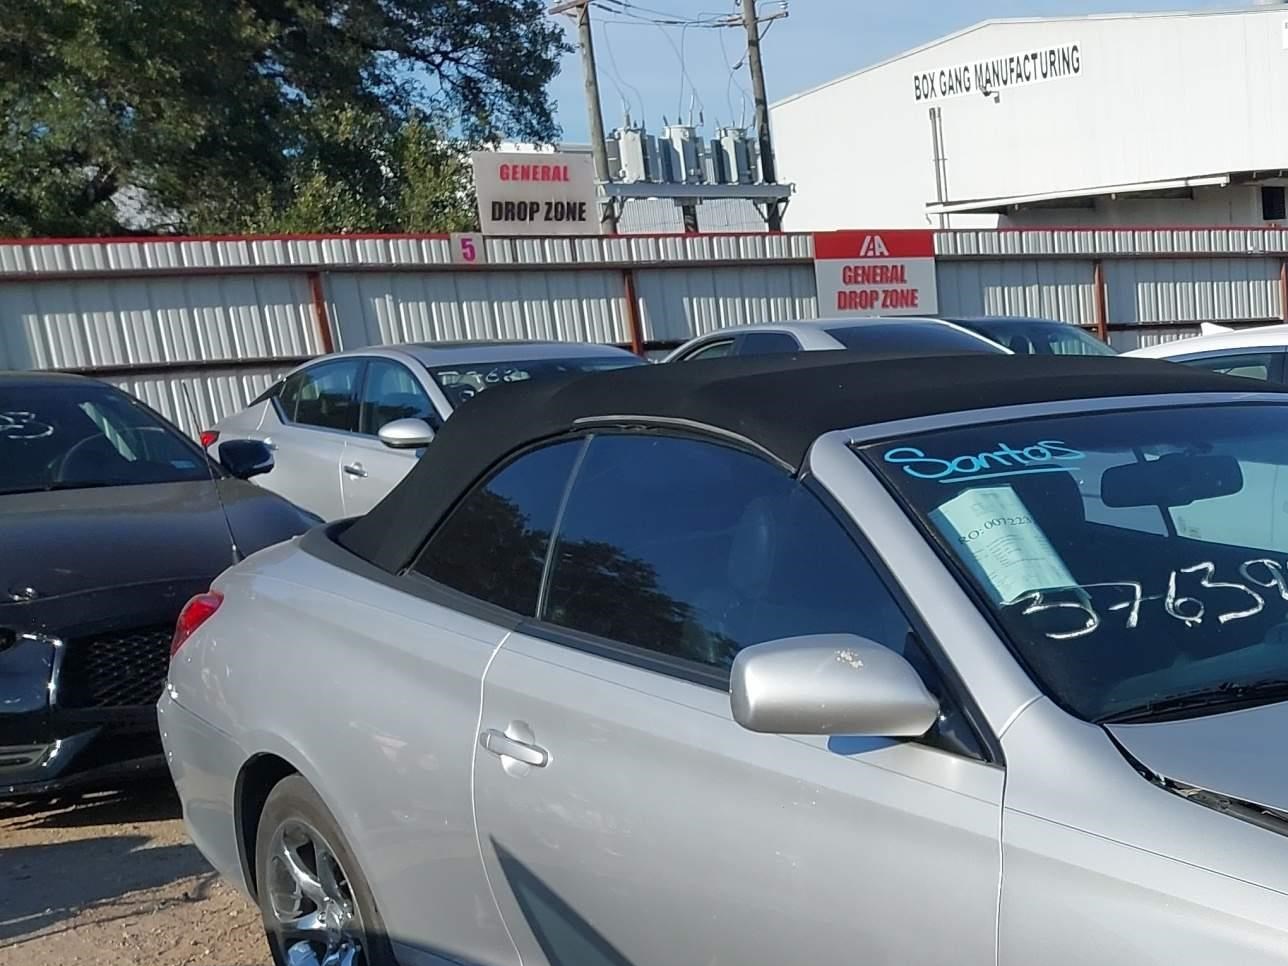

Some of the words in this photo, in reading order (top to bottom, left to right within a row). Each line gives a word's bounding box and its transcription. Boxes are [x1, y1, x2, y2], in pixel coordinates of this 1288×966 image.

[913, 72, 938, 101] BOX
[938, 65, 971, 96] GANG
[973, 44, 1081, 91] MANUFACTURING
[499, 164, 570, 182] GENERAL
[491, 201, 540, 222] DROP
[543, 202, 587, 222] ZONE
[460, 238, 476, 262] 5
[842, 265, 907, 285] GENERAL
[836, 289, 880, 311] DROP
[881, 288, 919, 309] ZONE
[884, 440, 1087, 479] Santos
